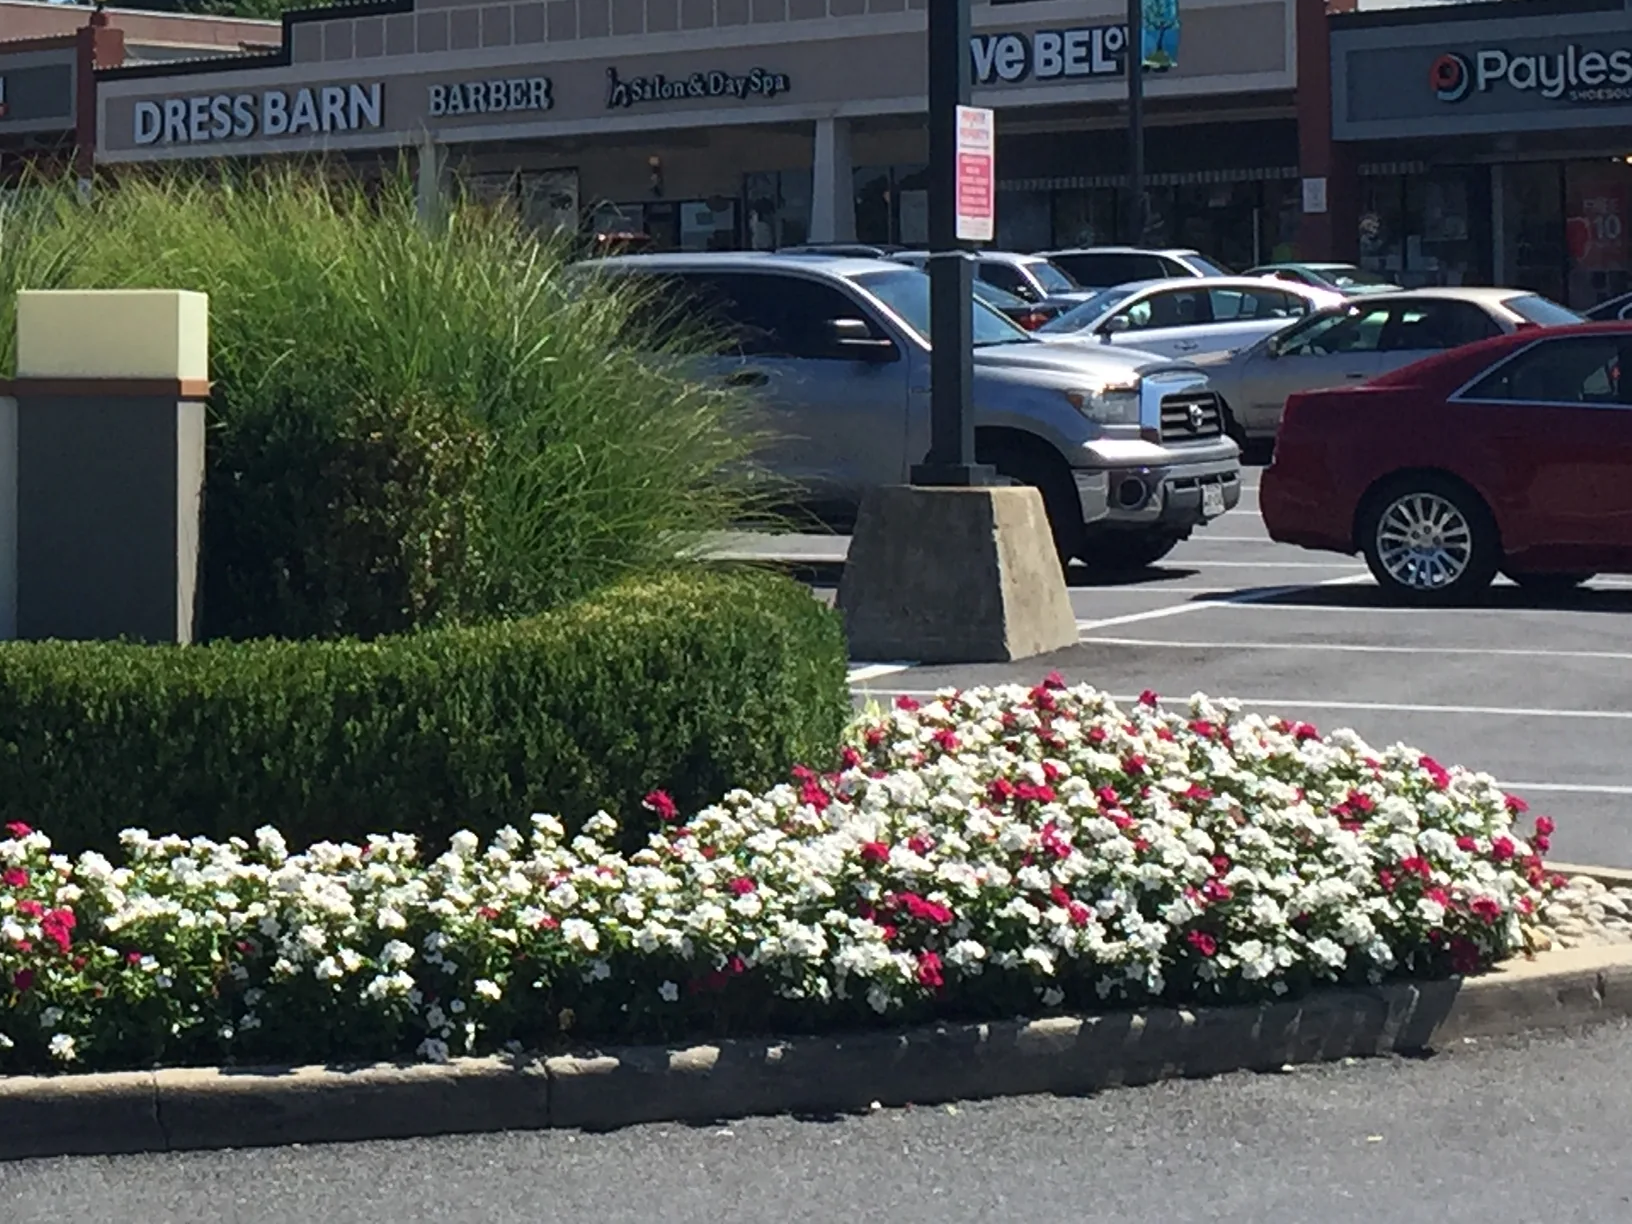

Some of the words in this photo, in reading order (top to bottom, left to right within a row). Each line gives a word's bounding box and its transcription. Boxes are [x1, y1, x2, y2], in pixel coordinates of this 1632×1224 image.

[970, 34, 1027, 80] ve
[1034, 26, 1129, 77] BELO
[1476, 44, 1632, 98] Payles
[427, 76, 551, 117] BARBER
[631, 76, 685, 102] Salon
[709, 71, 747, 99] Day
[749, 66, 786, 96] Spa
[1569, 87, 1632, 101] SHOESOU
[134, 93, 257, 145] DRESS
[262, 82, 383, 136] BARN
